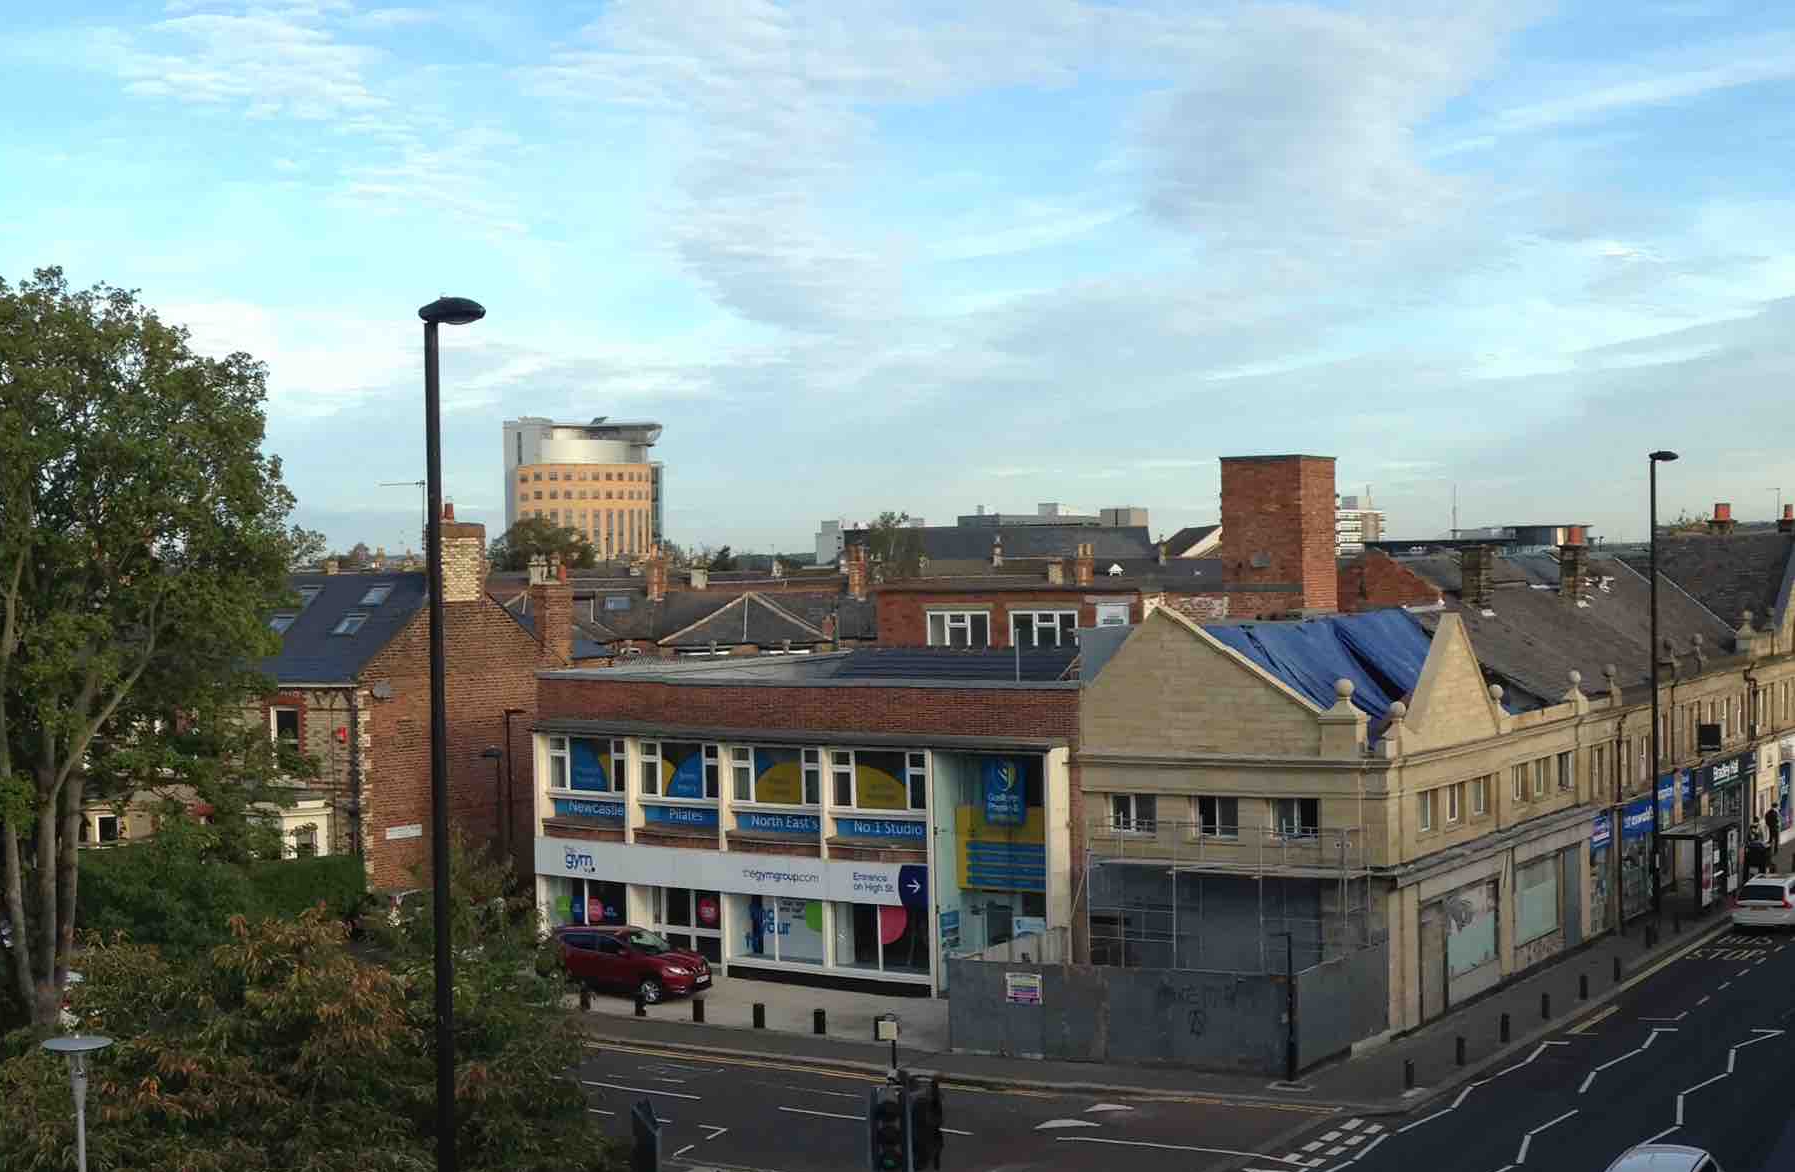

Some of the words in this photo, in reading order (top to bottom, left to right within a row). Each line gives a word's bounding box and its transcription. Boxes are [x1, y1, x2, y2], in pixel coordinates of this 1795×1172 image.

[568, 800, 624, 817] Newcastle
[669, 807, 704, 822] Pilates
[751, 814, 784, 828] North
[786, 815, 819, 831] East's
[884, 823, 924, 837] Studio
[565, 853, 593, 870] gym
[742, 868, 820, 884] thegymgroup.com
[853, 871, 888, 883] Entrance
[853, 883, 863, 891] on
[865, 882, 884, 894] High
